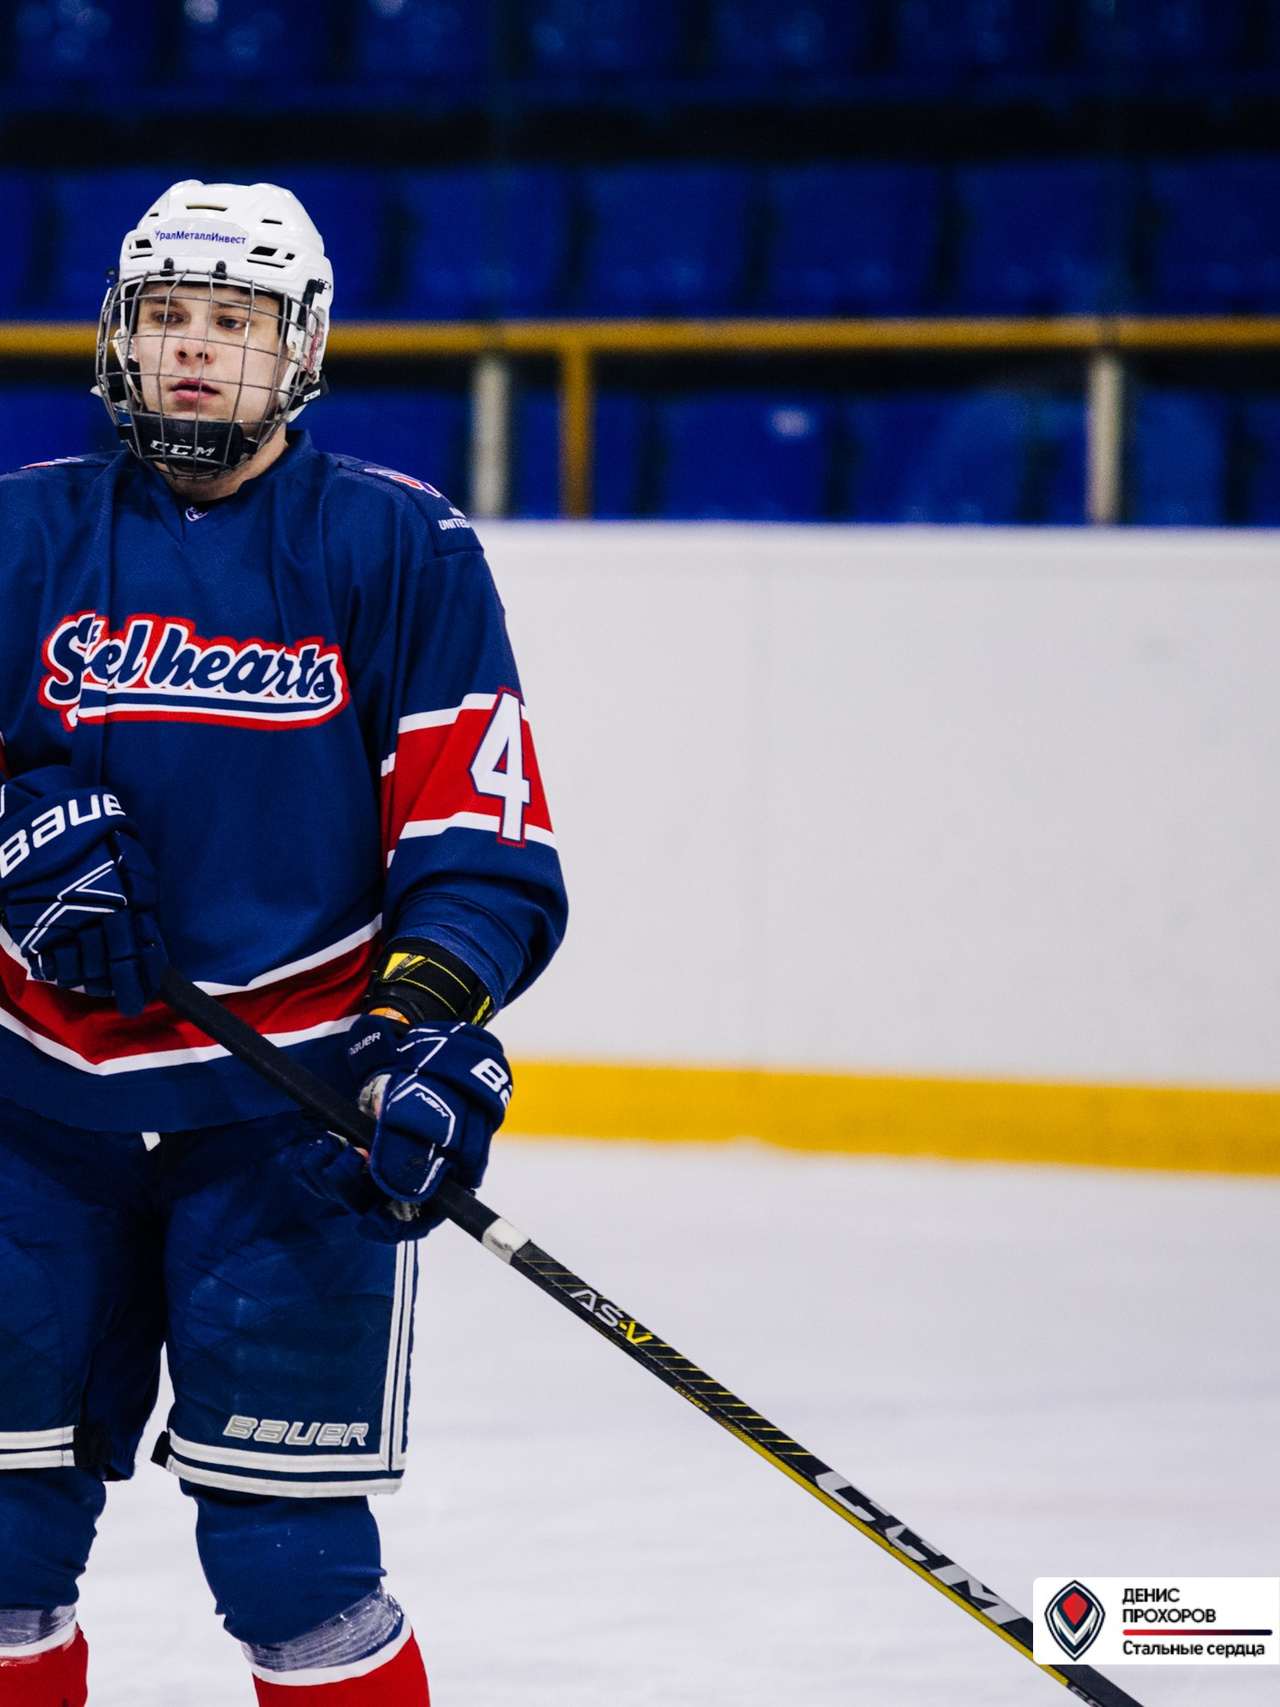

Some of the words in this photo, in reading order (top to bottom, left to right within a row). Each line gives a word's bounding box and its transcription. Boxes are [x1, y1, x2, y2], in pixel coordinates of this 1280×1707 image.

[155, 230, 246, 244] УралМеталлИнвест
[150, 440, 215, 456] CCM
[467, 686, 532, 848] 4
[570, 1288, 654, 1344] AS-V
[223, 1414, 369, 1447] BAUER
[815, 1470, 1026, 1626] CCM
